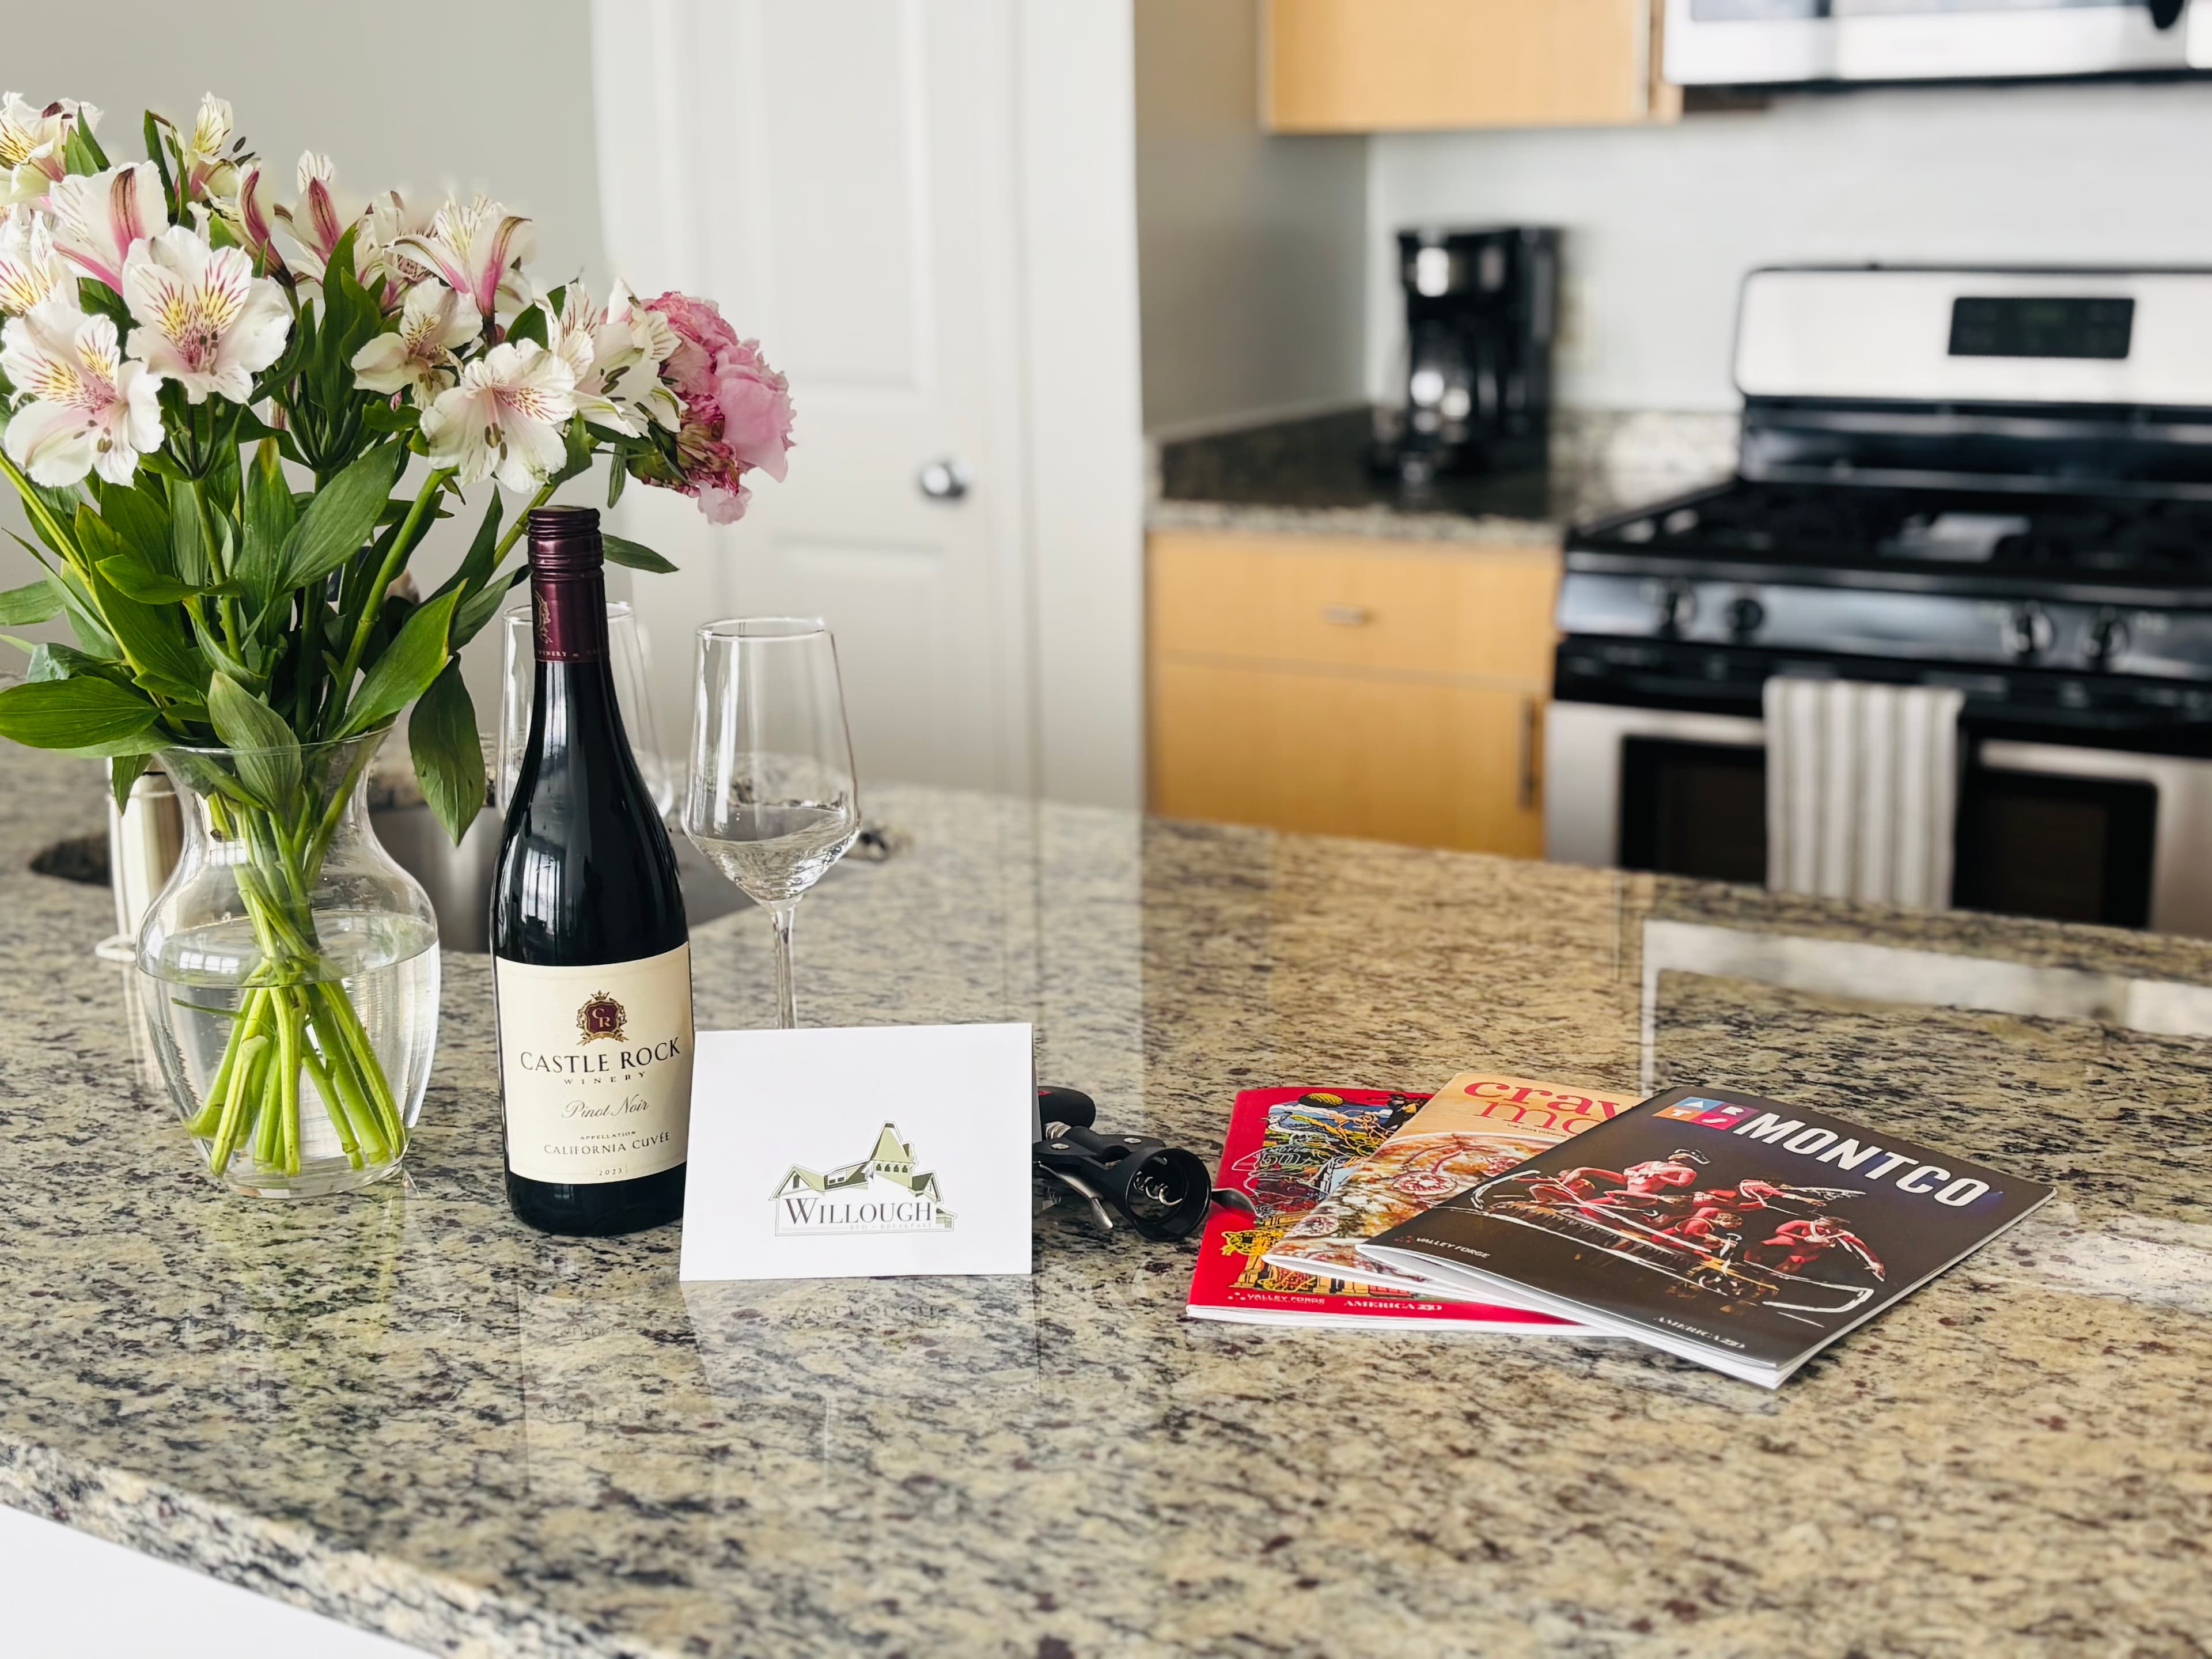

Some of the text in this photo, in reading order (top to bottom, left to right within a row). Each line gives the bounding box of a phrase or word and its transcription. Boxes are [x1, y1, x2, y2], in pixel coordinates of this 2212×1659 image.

[521, 1037, 680, 1073] CASTLE ROCK
[564, 1071, 645, 1084] WINERY
[562, 1094, 650, 1118] Pinot Noir
[544, 1132, 670, 1155] CALIFORNIA CUVÉE
[581, 1131, 636, 1139] APPELLATION
[1733, 1112, 1990, 1207] MONTCO
[784, 1198, 931, 1224] WILLOUGH
[1416, 1237, 1491, 1258] VALLEY FORGE
[1247, 1293, 1288, 1302] VALLEY
